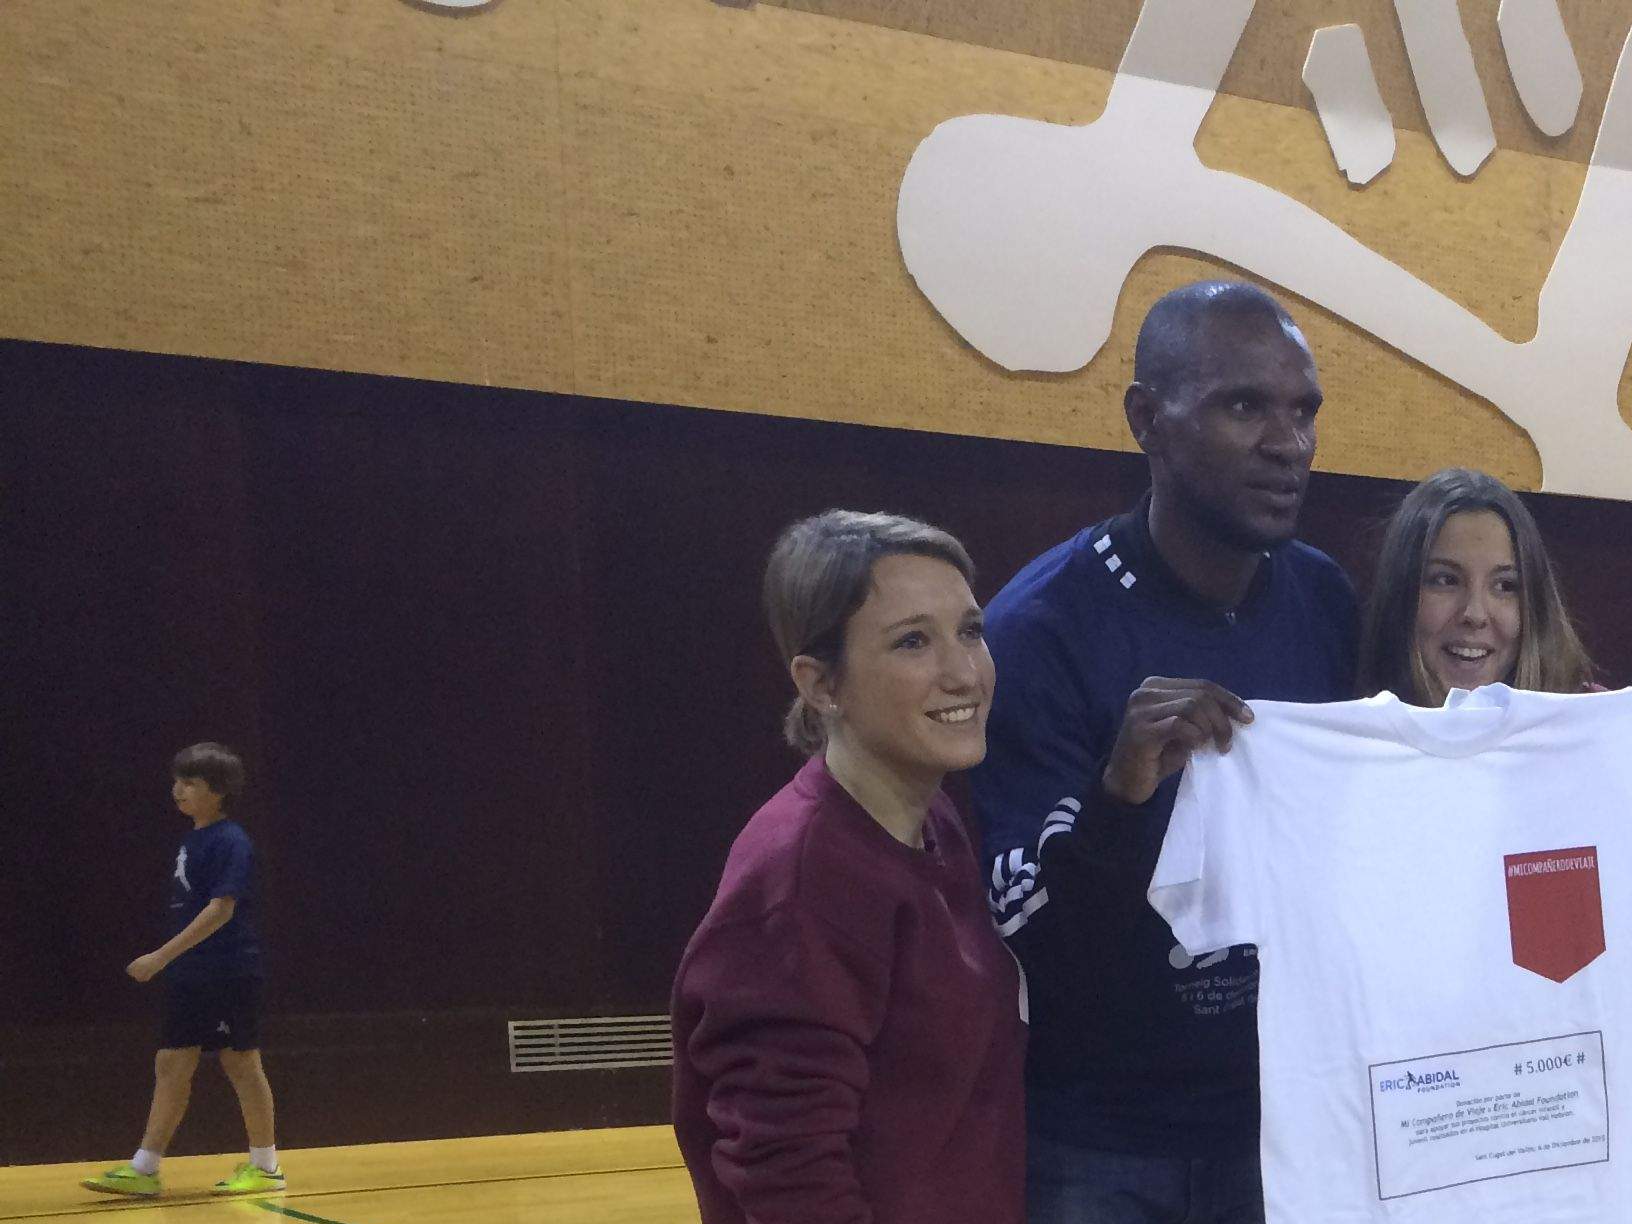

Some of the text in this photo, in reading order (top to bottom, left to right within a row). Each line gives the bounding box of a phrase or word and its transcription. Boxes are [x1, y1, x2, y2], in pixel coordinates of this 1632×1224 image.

[1526, 1053, 1573, 1074] 5.000€
[1380, 1069, 1460, 1092] ERIC ABIDAL
[1537, 1090, 1579, 1104] Foundation
